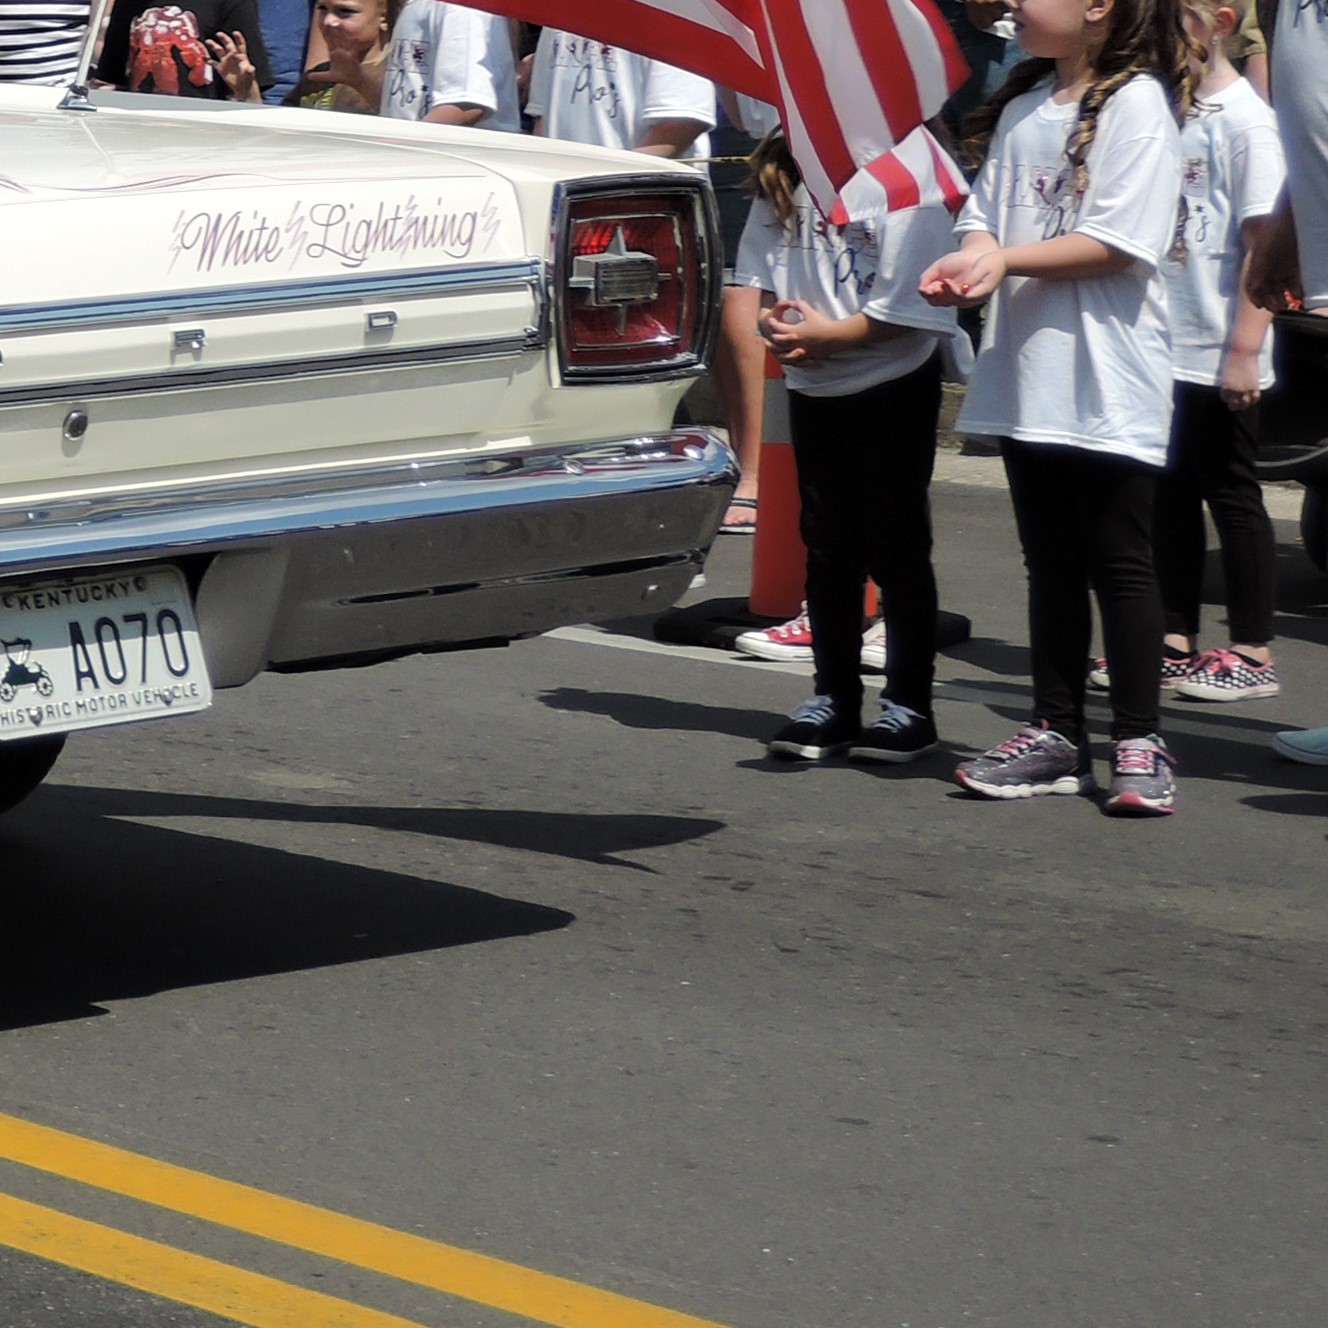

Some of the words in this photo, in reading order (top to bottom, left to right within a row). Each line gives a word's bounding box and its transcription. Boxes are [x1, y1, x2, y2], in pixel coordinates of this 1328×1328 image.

[181, 210, 283, 272] White
[306, 197, 478, 269] Lightning
[19, 581, 132, 611] KENTUCKY
[68, 608, 190, 692] A070
[0, 700, 72, 726] HISTRIC
[77, 693, 128, 715] MOTOR
[135, 682, 200, 706] VEHCLE
